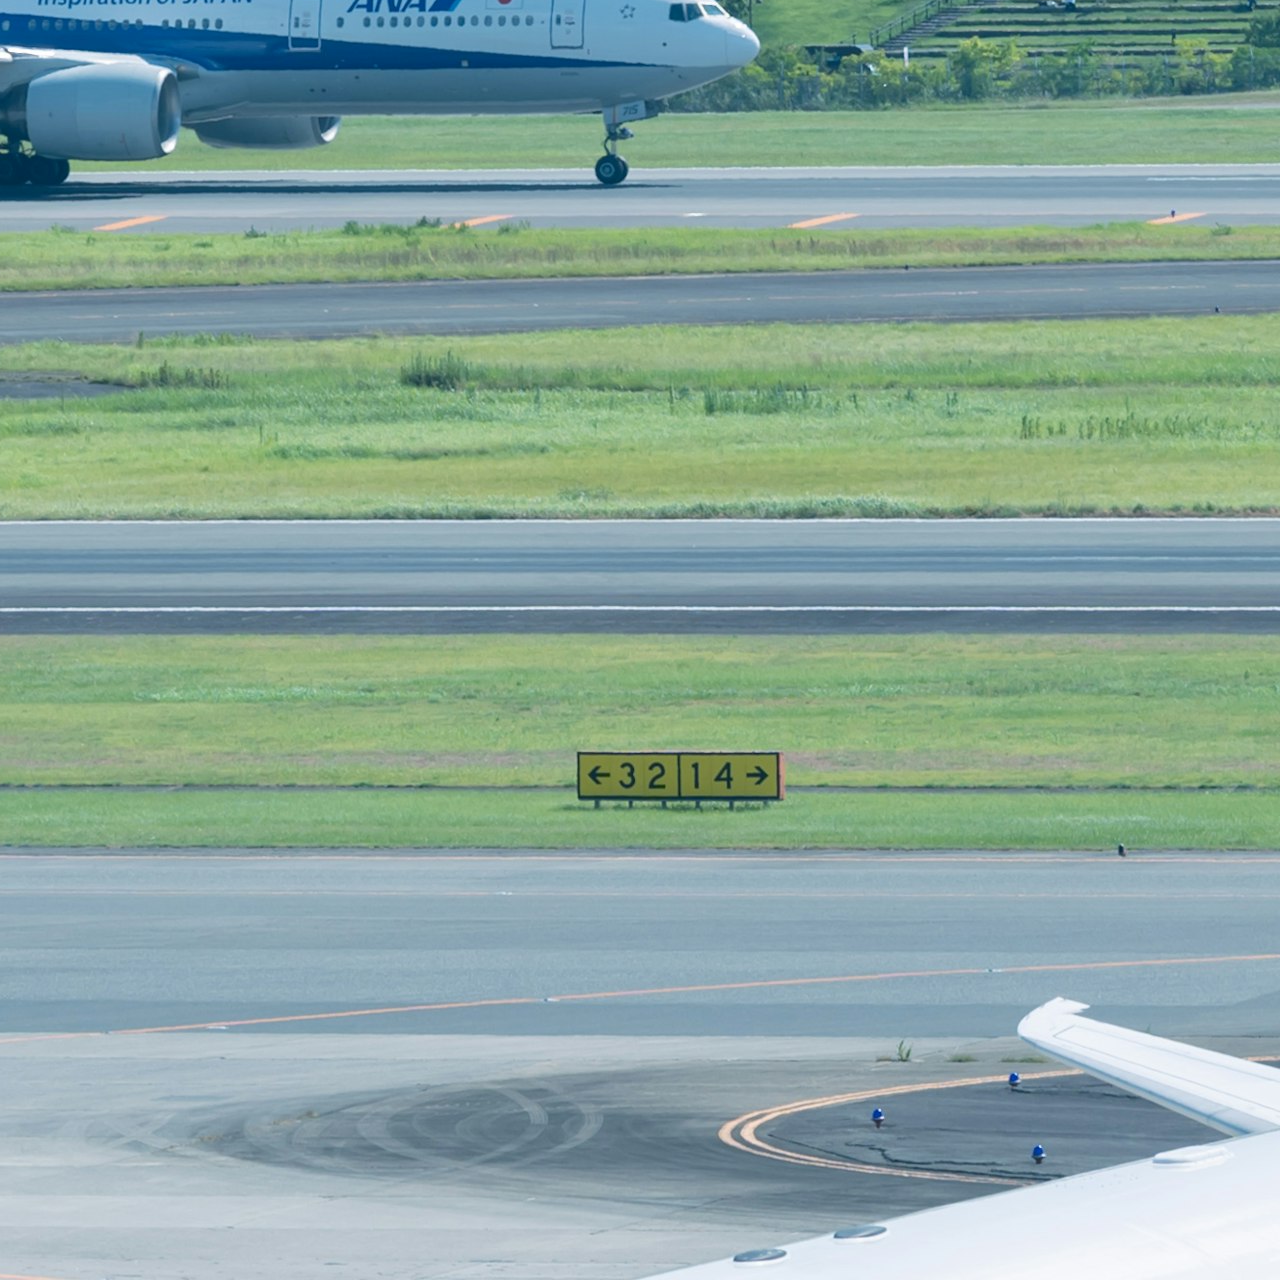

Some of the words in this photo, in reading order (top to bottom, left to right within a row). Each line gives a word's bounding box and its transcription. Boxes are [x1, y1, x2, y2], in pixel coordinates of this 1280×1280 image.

[623, 104, 639, 116] 715
[619, 762, 666, 789] 32
[691, 762, 733, 789] 14
